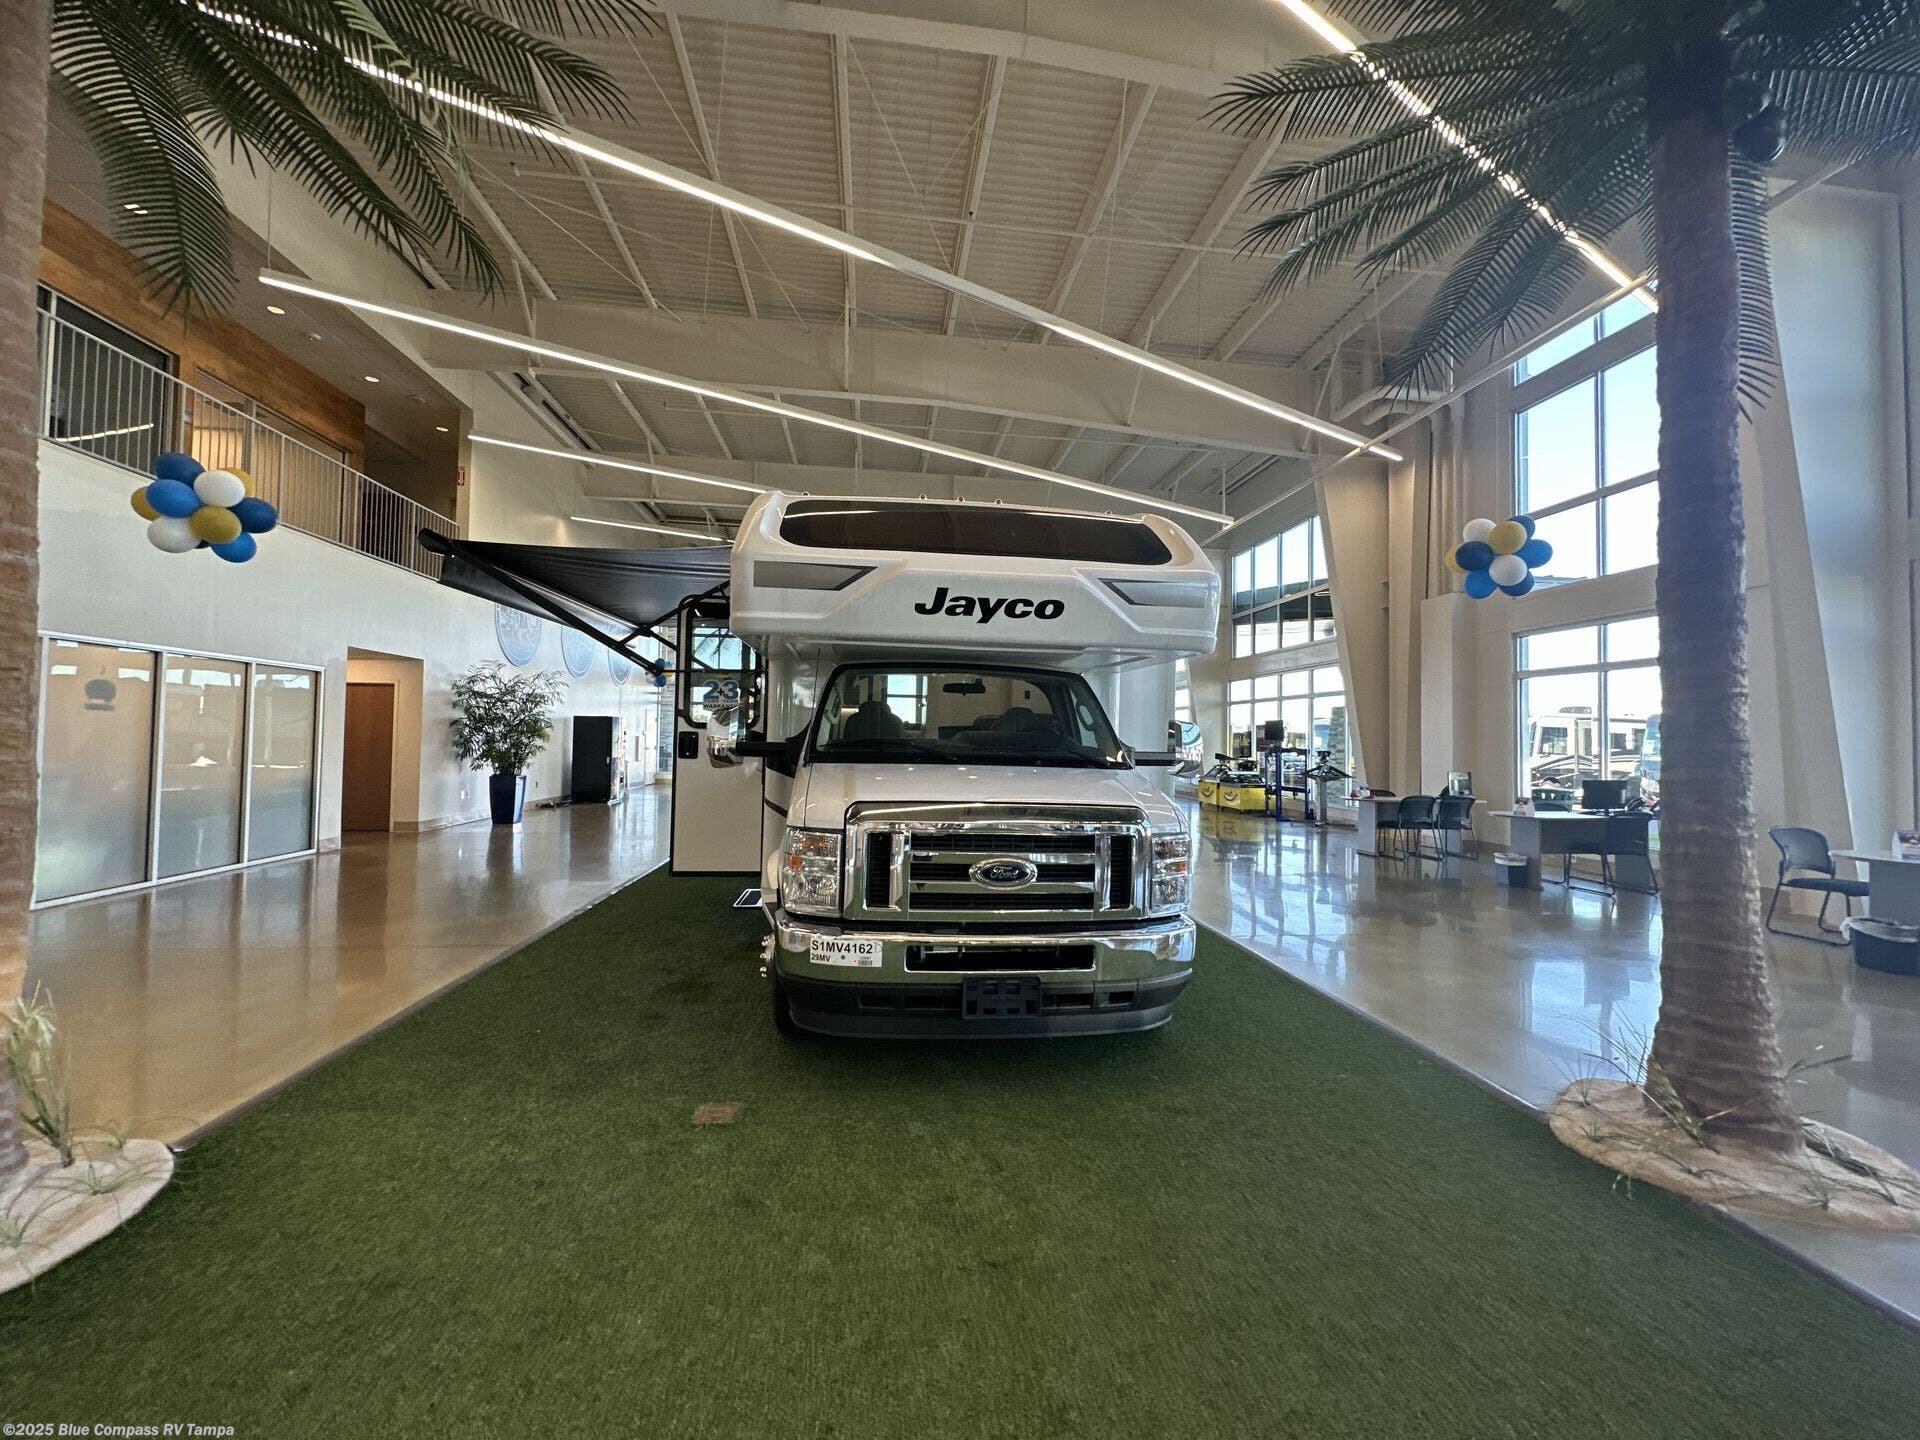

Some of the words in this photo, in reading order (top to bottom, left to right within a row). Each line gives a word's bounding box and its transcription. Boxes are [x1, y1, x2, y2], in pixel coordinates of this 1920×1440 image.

[914, 587, 1065, 624] Jayco
[990, 865, 1020, 879] Ford
[812, 940, 873, 954] S1MV4162
[811, 953, 831, 962] 29MV
